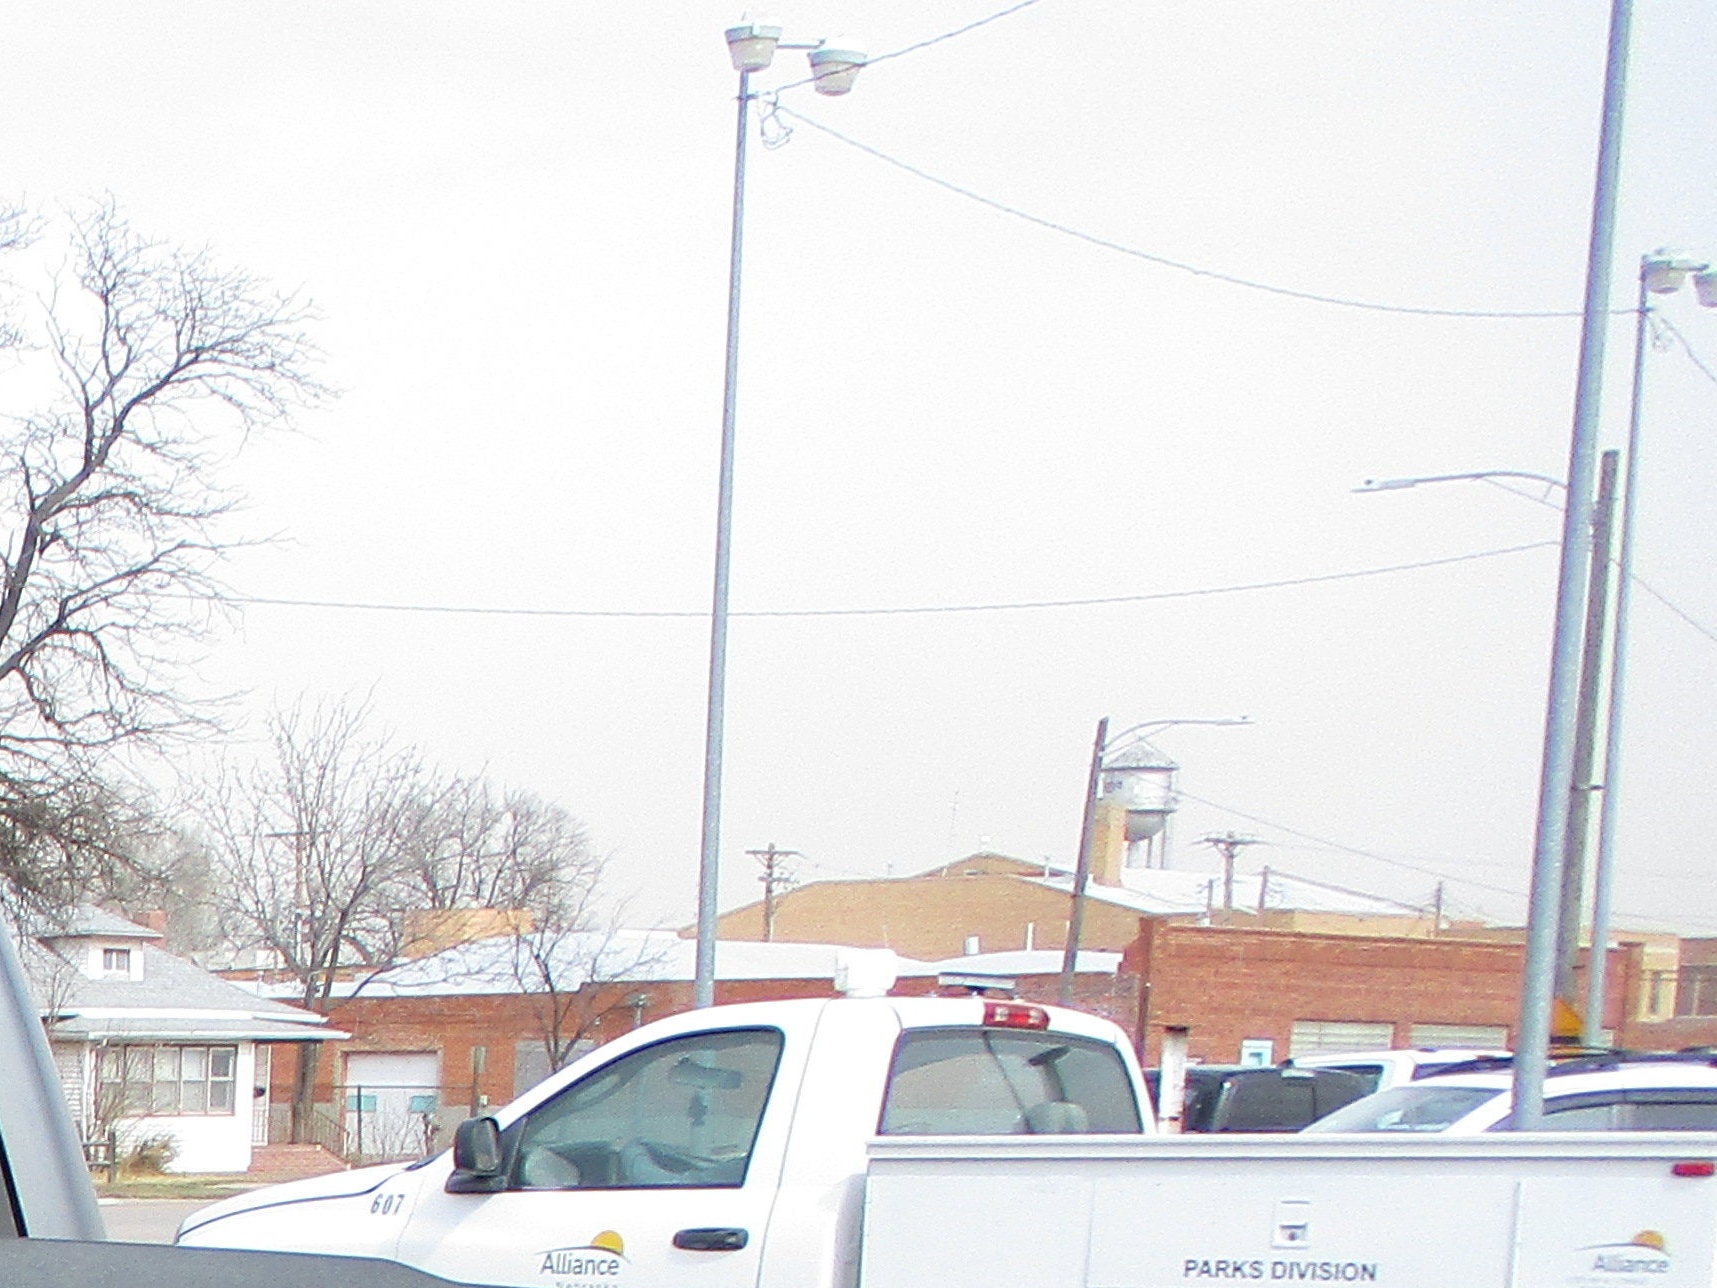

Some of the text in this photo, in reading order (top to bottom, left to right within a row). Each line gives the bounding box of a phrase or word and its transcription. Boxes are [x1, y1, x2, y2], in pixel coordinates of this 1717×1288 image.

[370, 1193, 405, 1215] 607
[539, 1252, 620, 1275] Alliance
[1184, 1259, 1378, 1282] PARKS DIVISION
